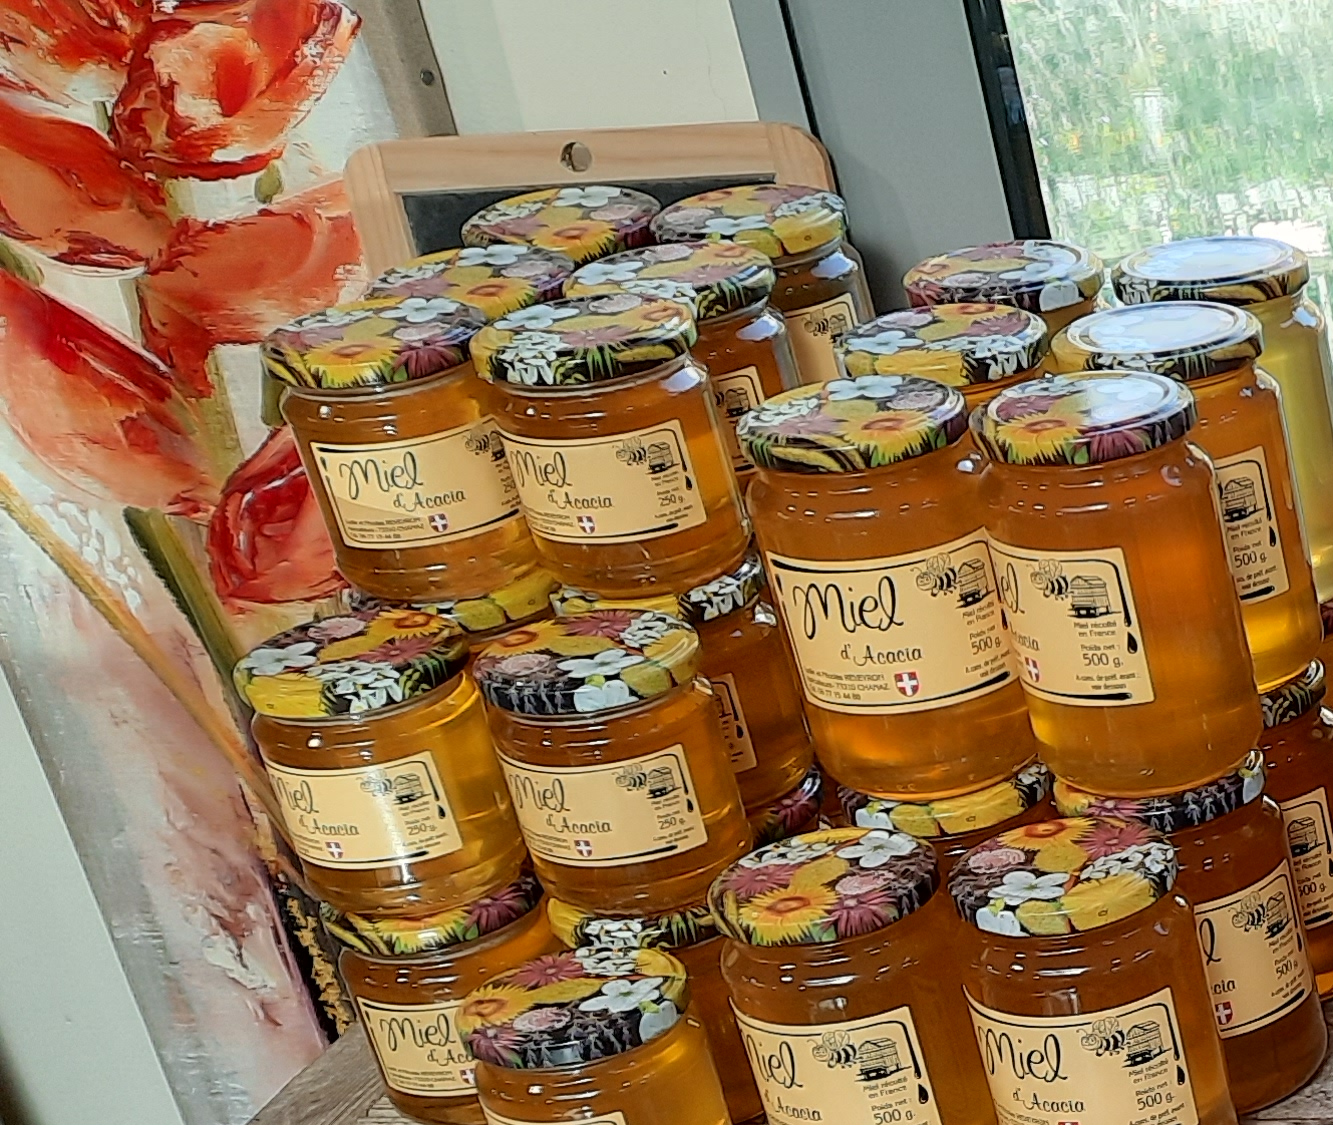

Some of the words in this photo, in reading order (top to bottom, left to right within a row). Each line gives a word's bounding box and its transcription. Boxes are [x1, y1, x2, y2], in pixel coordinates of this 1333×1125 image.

[339, 451, 424, 500] Miel
[508, 449, 570, 488] Miel
[394, 489, 466, 513] d'Acacia
[546, 488, 612, 510] d'Acacia
[1234, 550, 1258, 569] 500
[1000, 562, 1025, 614] el
[793, 576, 904, 640] Miel
[840, 643, 923, 667] d'Acacia
[971, 636, 993, 656] 500
[1082, 652, 1109, 667] 500
[508, 773, 571, 813] Miel
[379, 1013, 456, 1053] Miel
[978, 1025, 1068, 1083] Miel
[1012, 1087, 1086, 1114] d'Acacia
[1136, 1092, 1163, 1112] 500
